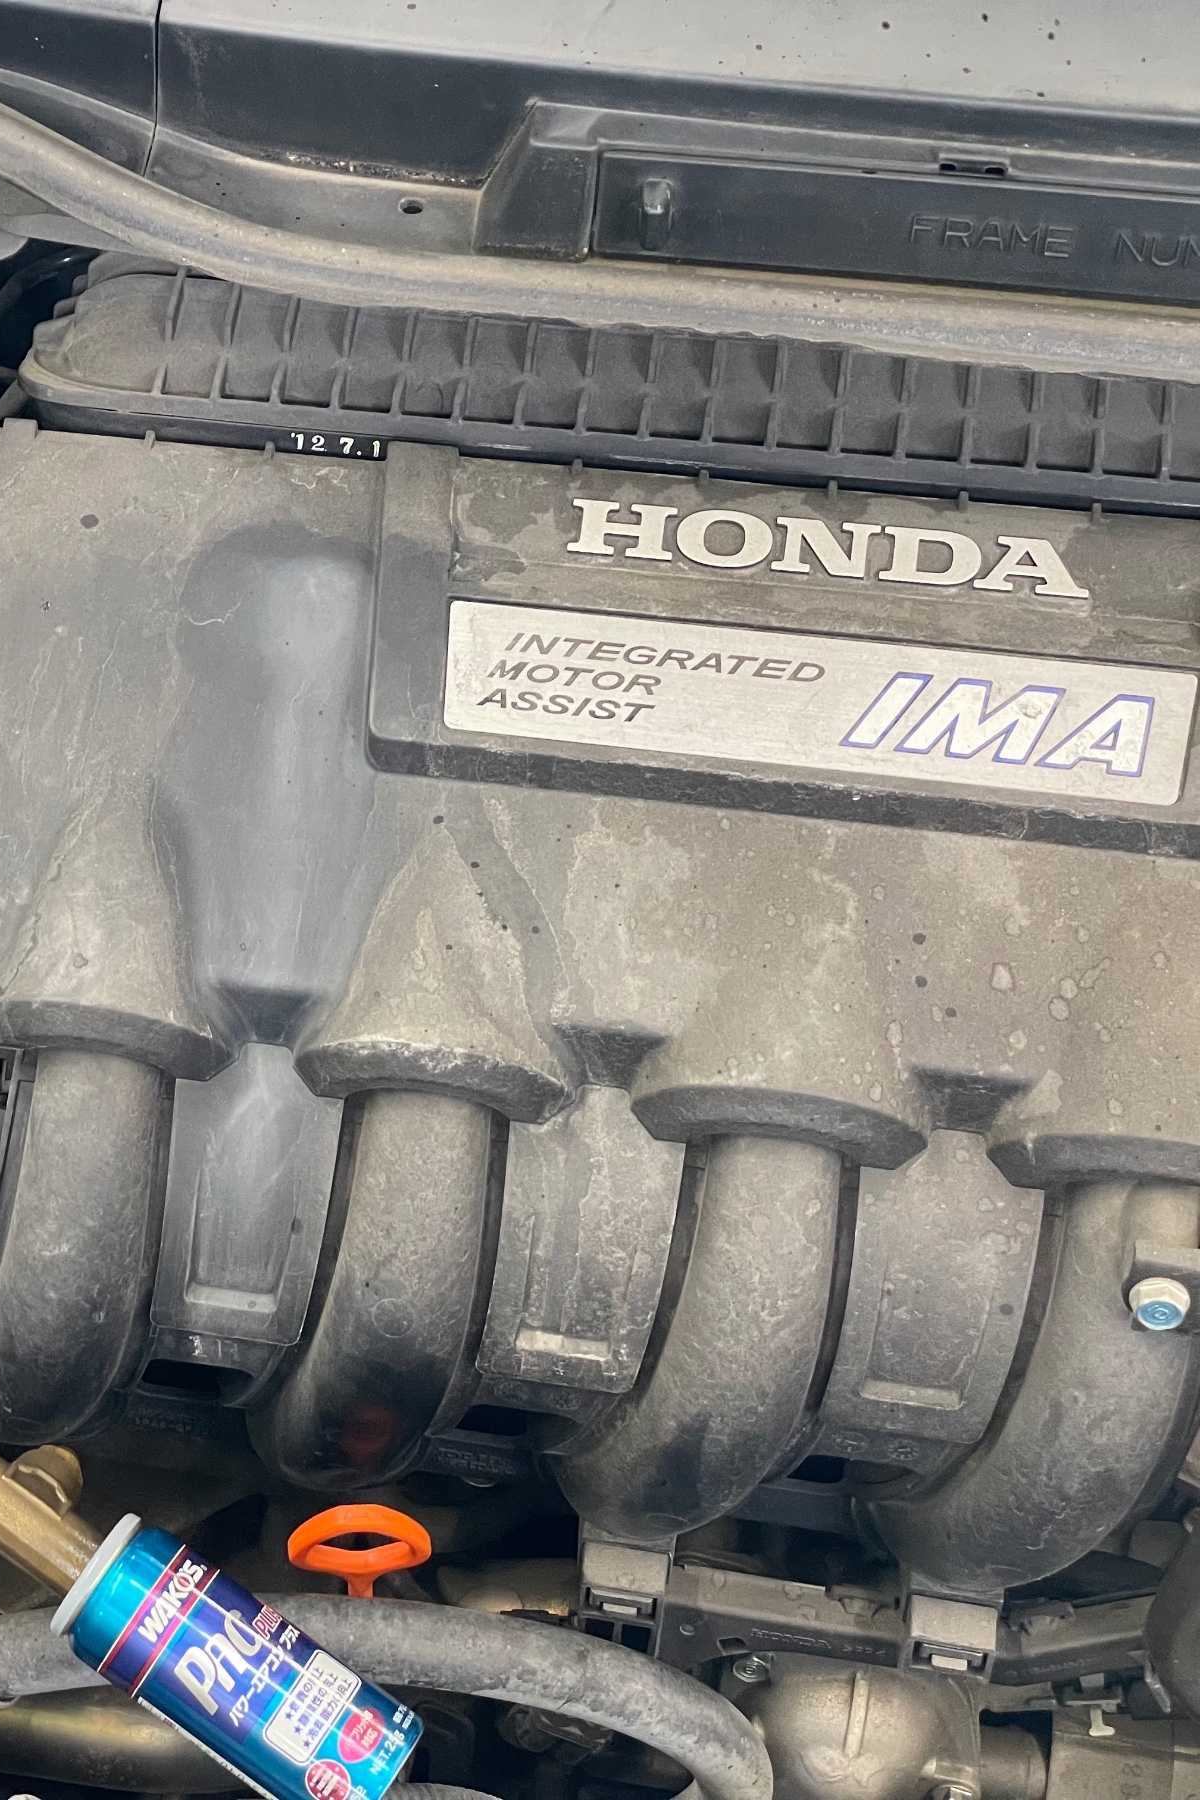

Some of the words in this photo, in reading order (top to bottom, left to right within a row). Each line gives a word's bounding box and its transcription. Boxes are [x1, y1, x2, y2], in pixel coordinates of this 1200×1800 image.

[910, 213, 1074, 258] FRAME
[567, 498, 1090, 600] HONDA
[486, 659, 662, 696] MOTOR
[504, 631, 826, 683] INTEGRATED
[476, 688, 656, 723] ASSIST
[840, 672, 1155, 777] IMA
[173, 1609, 264, 1716] PAC
